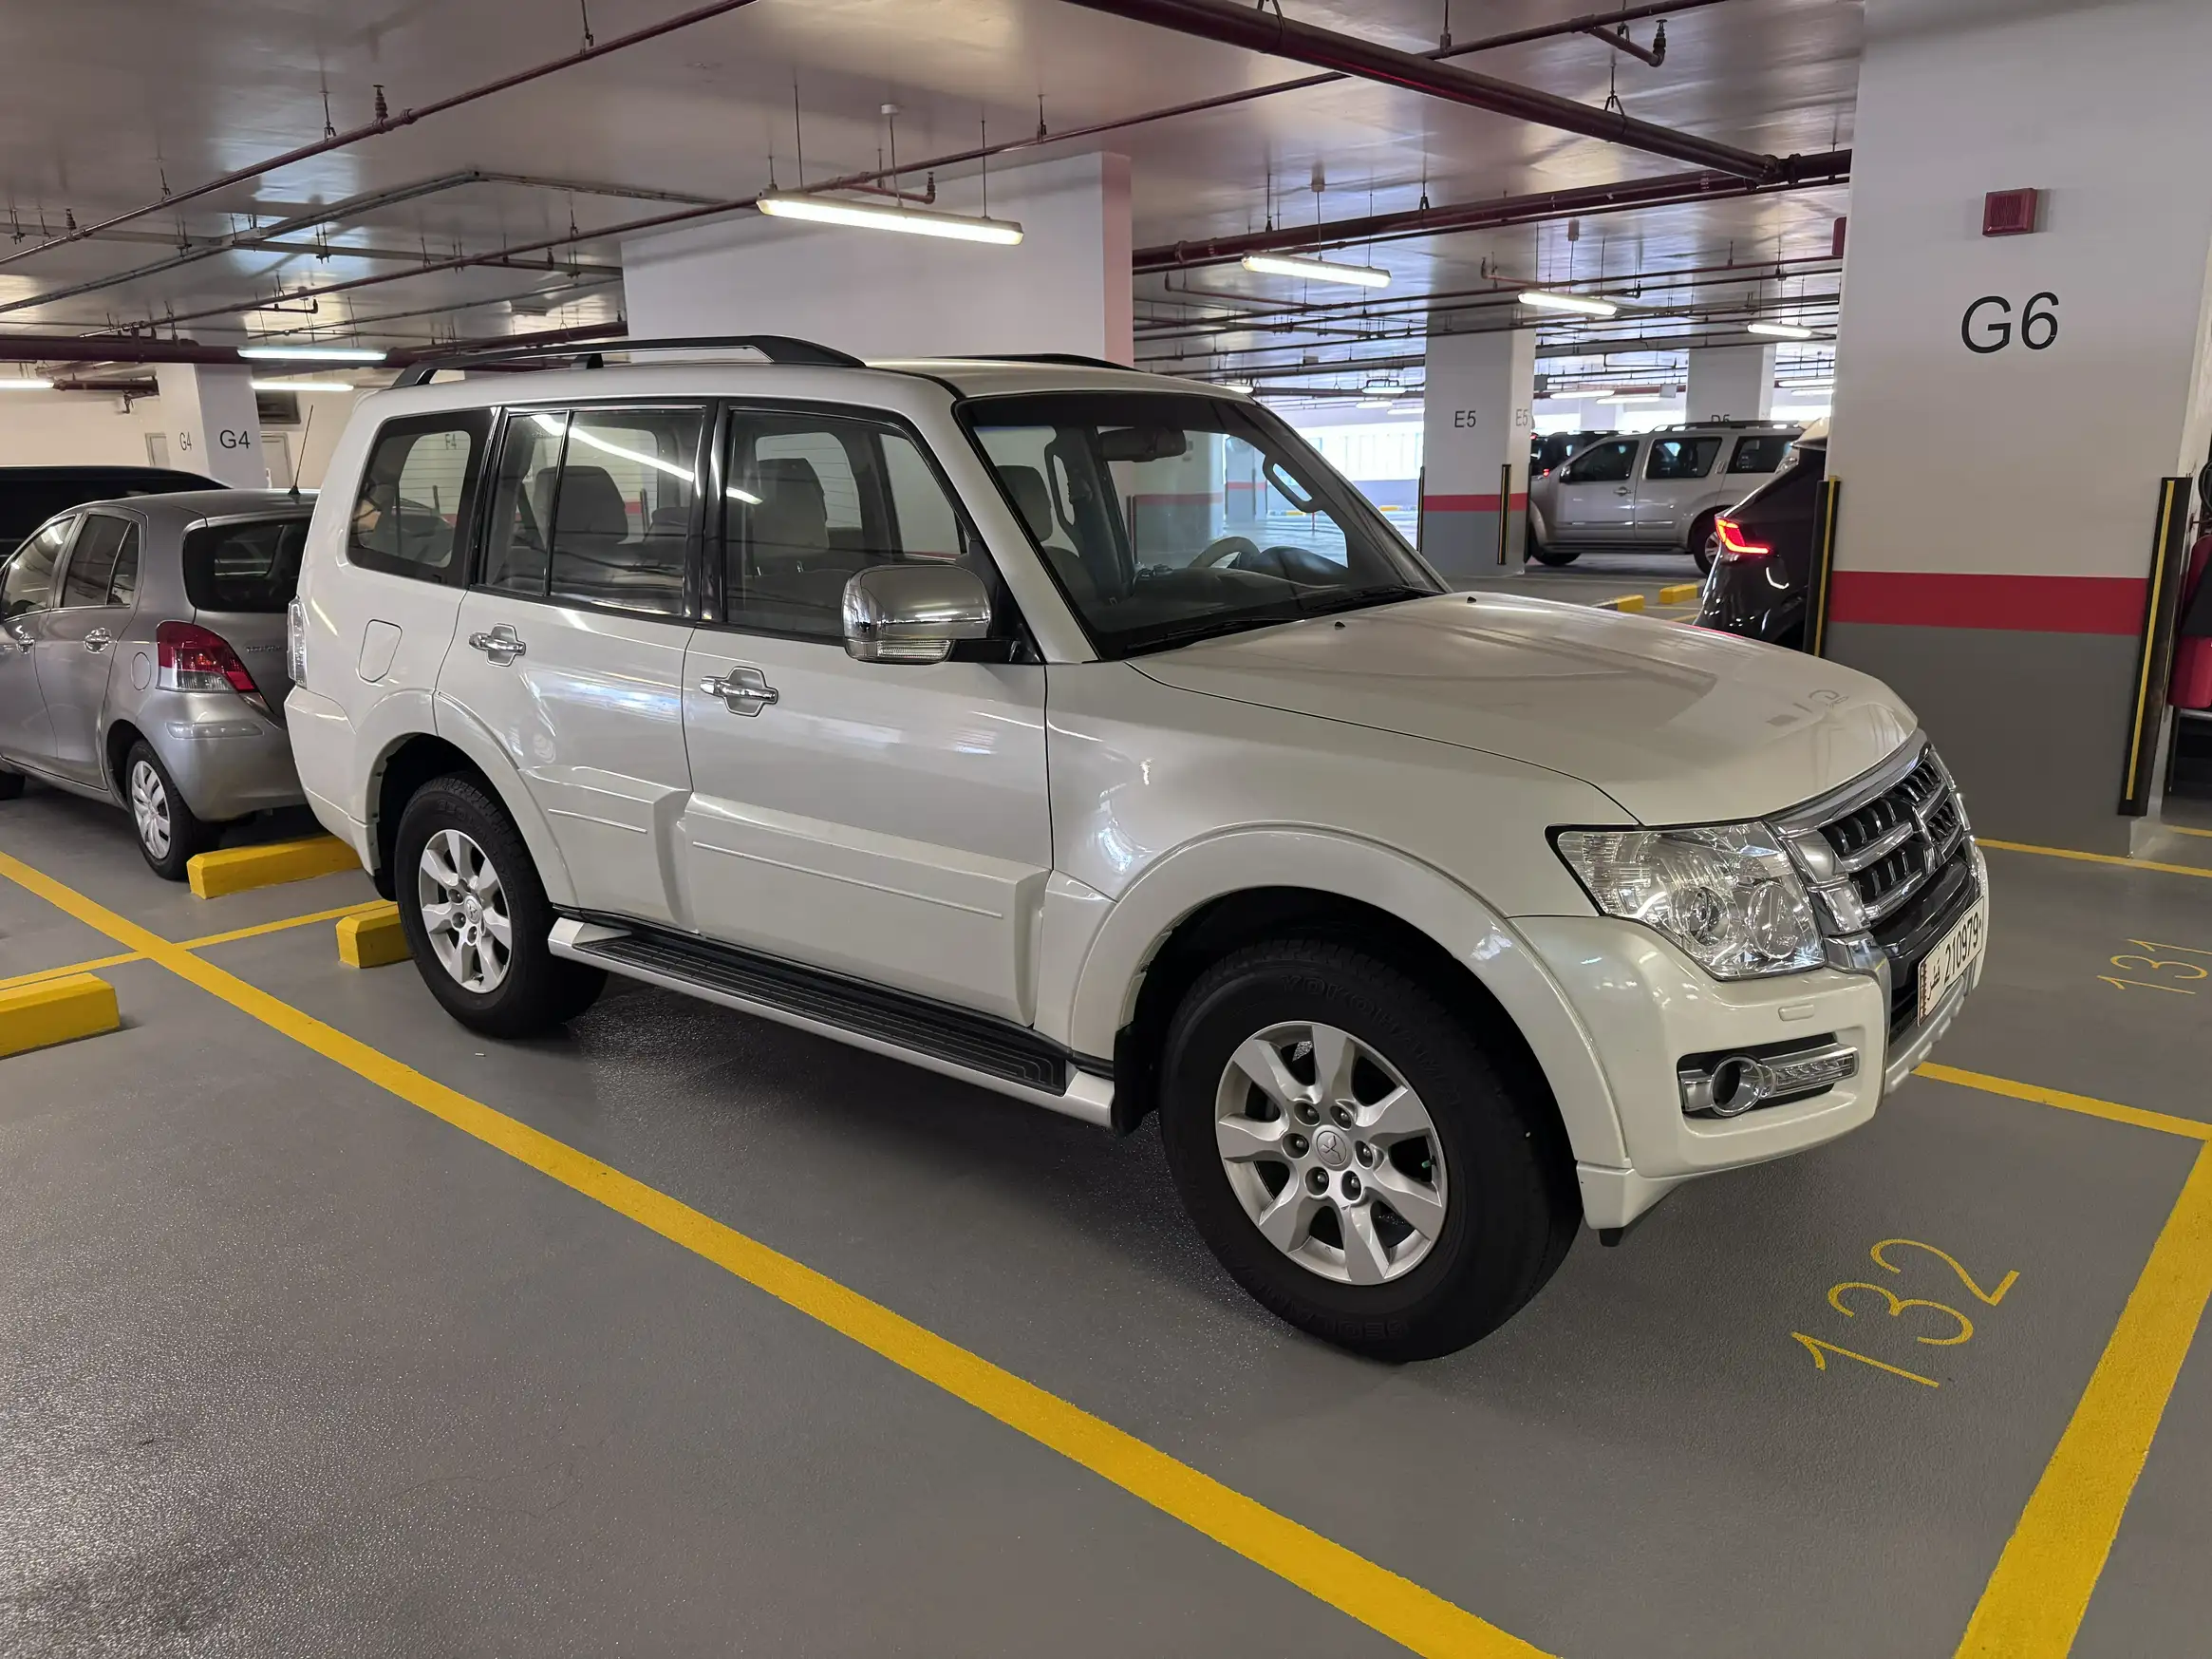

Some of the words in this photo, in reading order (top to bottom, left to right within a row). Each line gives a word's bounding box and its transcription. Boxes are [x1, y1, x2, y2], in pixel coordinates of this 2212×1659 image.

[1961, 292, 2059, 354] G6
[1454, 410, 1476, 428] E5
[1515, 408, 1528, 426] E5
[178, 431, 192, 451] G4
[219, 429, 251, 449] G4
[444, 433, 457, 450] F4
[1943, 911, 1978, 985] 210979
[2096, 938, 2212, 994] 131
[1281, 973, 1463, 1106] YOKOHAMA
[1791, 1238, 2020, 1387] 132
